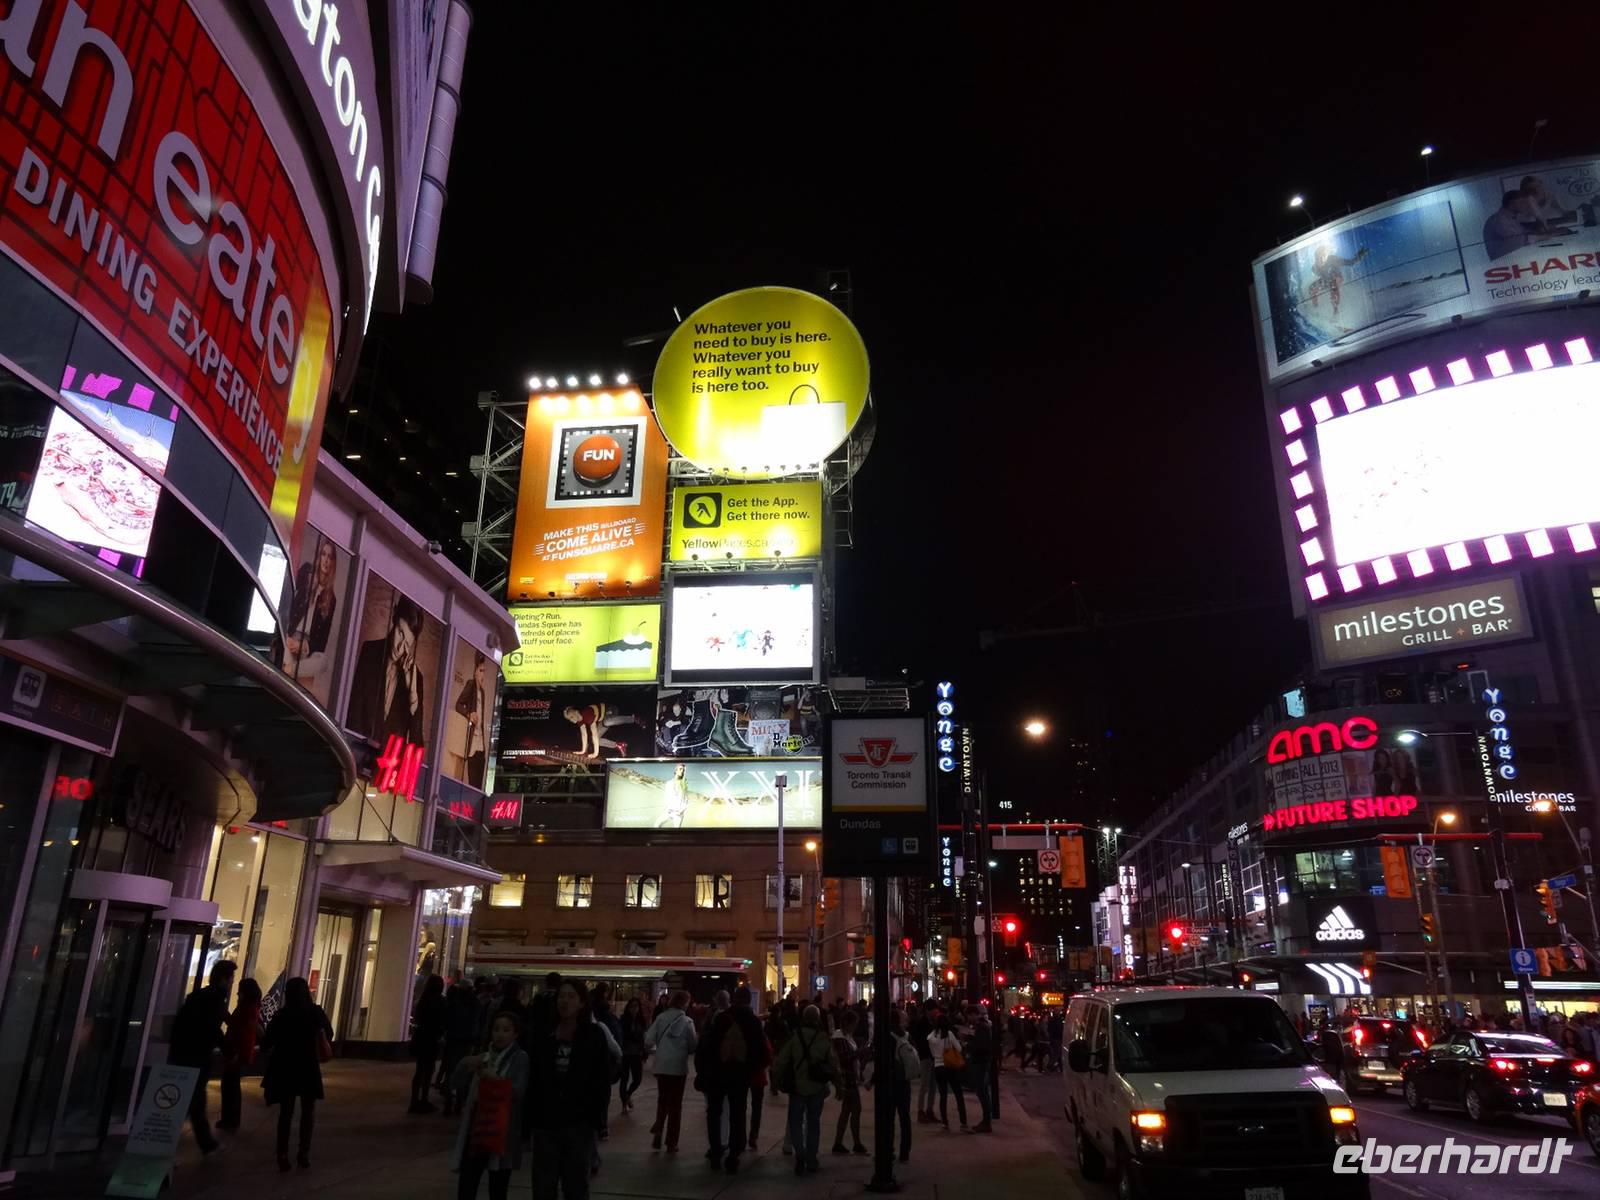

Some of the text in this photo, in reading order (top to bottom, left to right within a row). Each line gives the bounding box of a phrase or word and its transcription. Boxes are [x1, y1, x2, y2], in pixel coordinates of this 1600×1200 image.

[1484, 252, 1600, 284] SHAR
[1487, 279, 1569, 300] Technology
[14, 148, 285, 474] DINING EXPERIENCE
[694, 320, 791, 335] Whatever you
[694, 330, 831, 349] need to buy is here.
[693, 349, 791, 364] Whatever you
[692, 361, 819, 380] really want to buy
[691, 379, 769, 393] is here too.
[583, 449, 614, 461] FUN
[727, 497, 799, 508] Get the App.
[727, 511, 810, 521] Get there now.
[543, 517, 636, 540] MAKE THIS BILLBOARD
[546, 526, 632, 552] COME ALIVE
[552, 538, 634, 561] FUNSQUARE.CA
[514, 613, 544, 621] Dieting?
[541, 621, 566, 629] Square
[1334, 596, 1504, 642] milestones
[521, 629, 545, 637] ndreds
[556, 629, 579, 637] places
[1402, 619, 1512, 646] GRILL BAR
[937, 682, 955, 772] Yonge
[1485, 688, 1517, 779] Yonge
[847, 771, 879, 779] Toronto
[1319, 760, 1338, 776] 2013
[1477, 736, 1497, 802] DOWNTOWN
[851, 780, 906, 788] Commission
[1276, 795, 1418, 830] FUTURE SHOP
[840, 818, 881, 829] Dundas
[1119, 866, 1130, 925] FUTURE
[1316, 928, 1364, 941] adidas
